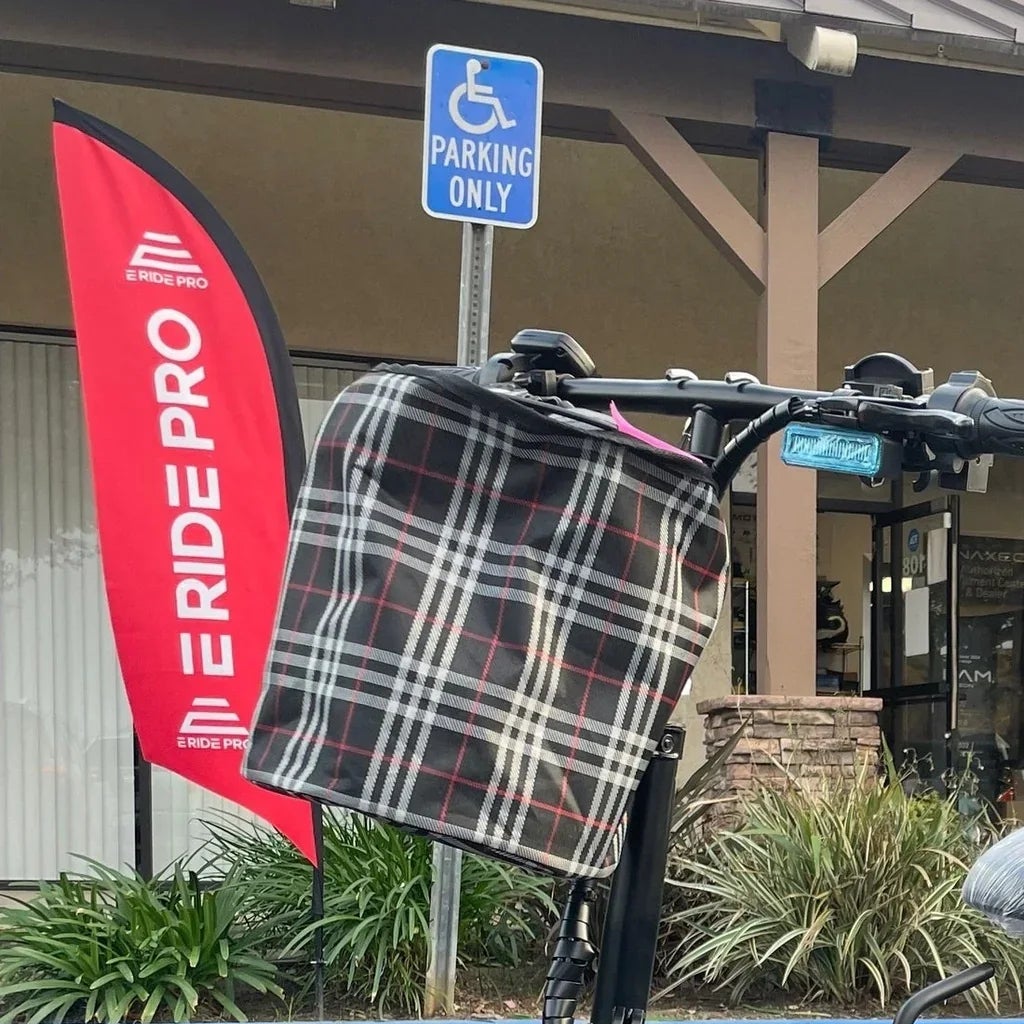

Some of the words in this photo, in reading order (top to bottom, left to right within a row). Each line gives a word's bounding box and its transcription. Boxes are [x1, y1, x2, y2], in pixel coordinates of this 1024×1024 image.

[431, 135, 533, 178] PARKING
[449, 175, 513, 213] ONLY
[125, 269, 138, 281] E
[138, 270, 175, 286] RIDE
[176, 277, 209, 289] PRO
[146, 308, 216, 451] PRO
[164, 464, 231, 621] RIDE
[180, 632, 235, 677] E
[177, 736, 187, 749] E
[187, 737, 221, 749] RIDE
